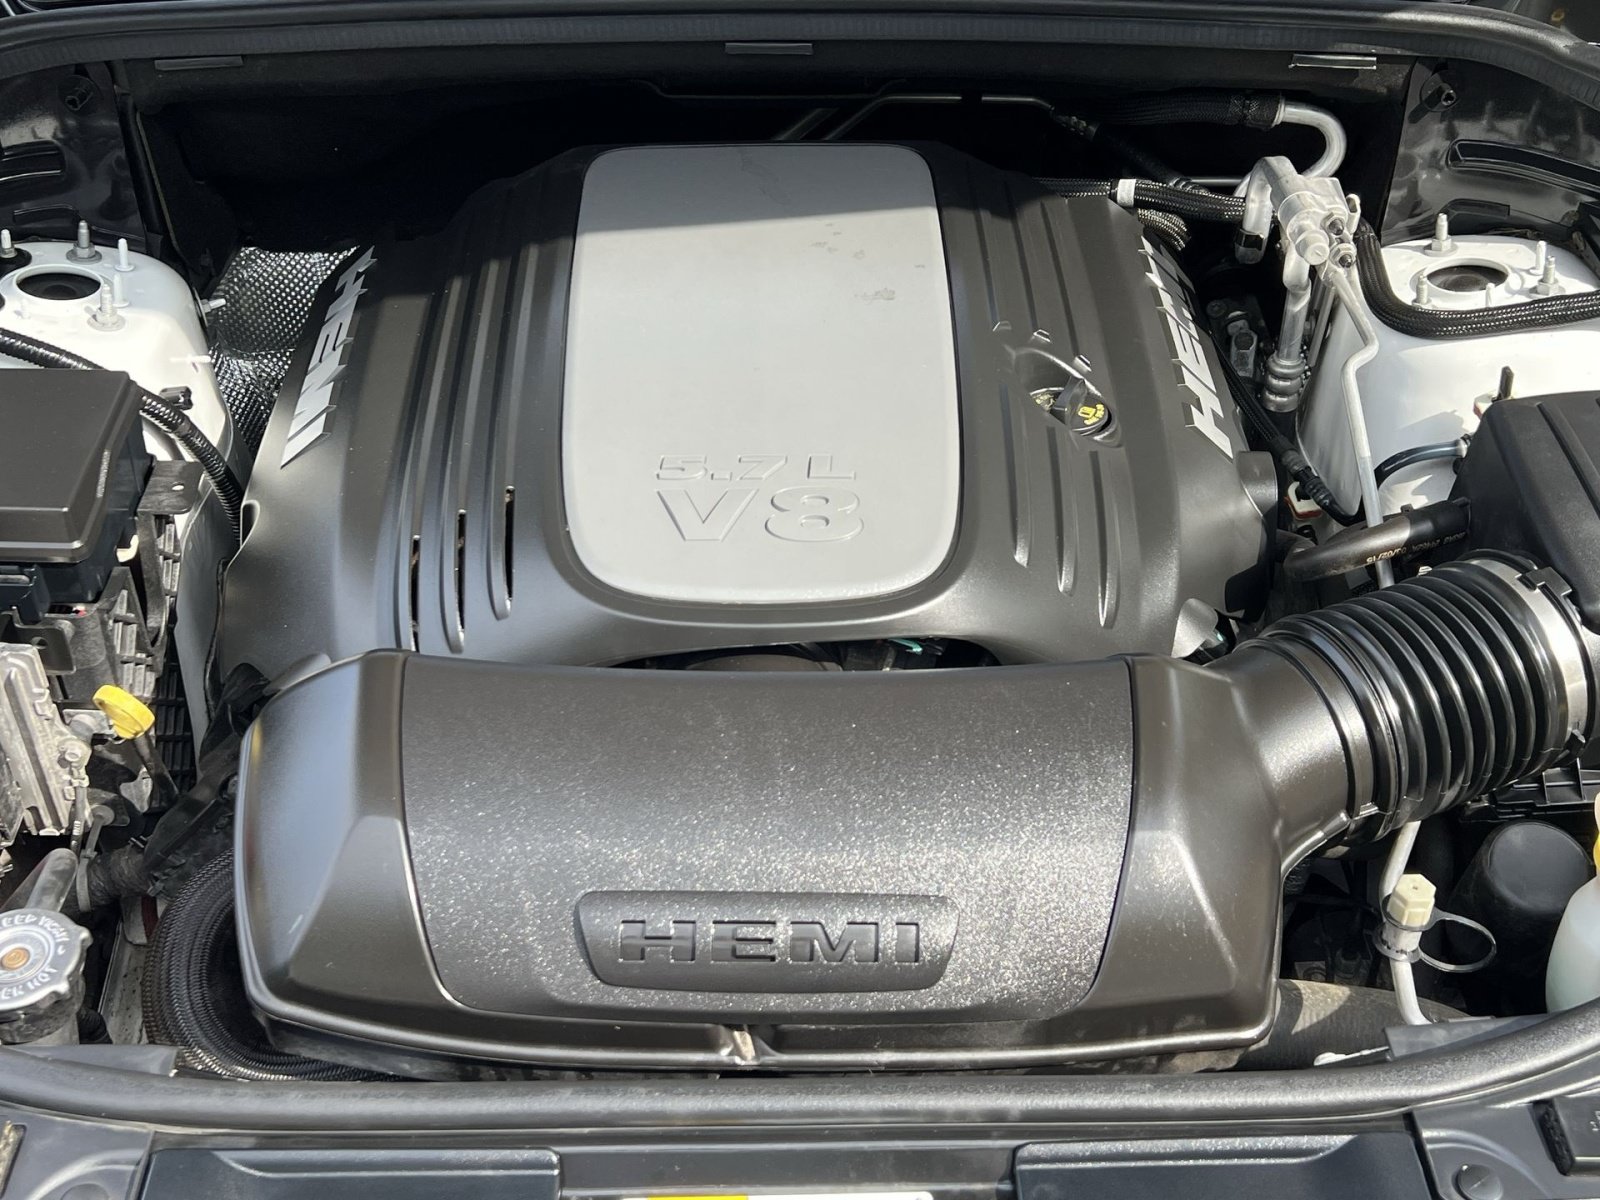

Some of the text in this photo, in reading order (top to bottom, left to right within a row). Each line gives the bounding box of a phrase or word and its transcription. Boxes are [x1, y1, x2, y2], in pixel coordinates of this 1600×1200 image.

[281, 246, 378, 469] HEMI
[1138, 235, 1233, 463] HEMI
[655, 485, 864, 542] V8
[619, 919, 920, 963] HEMI
